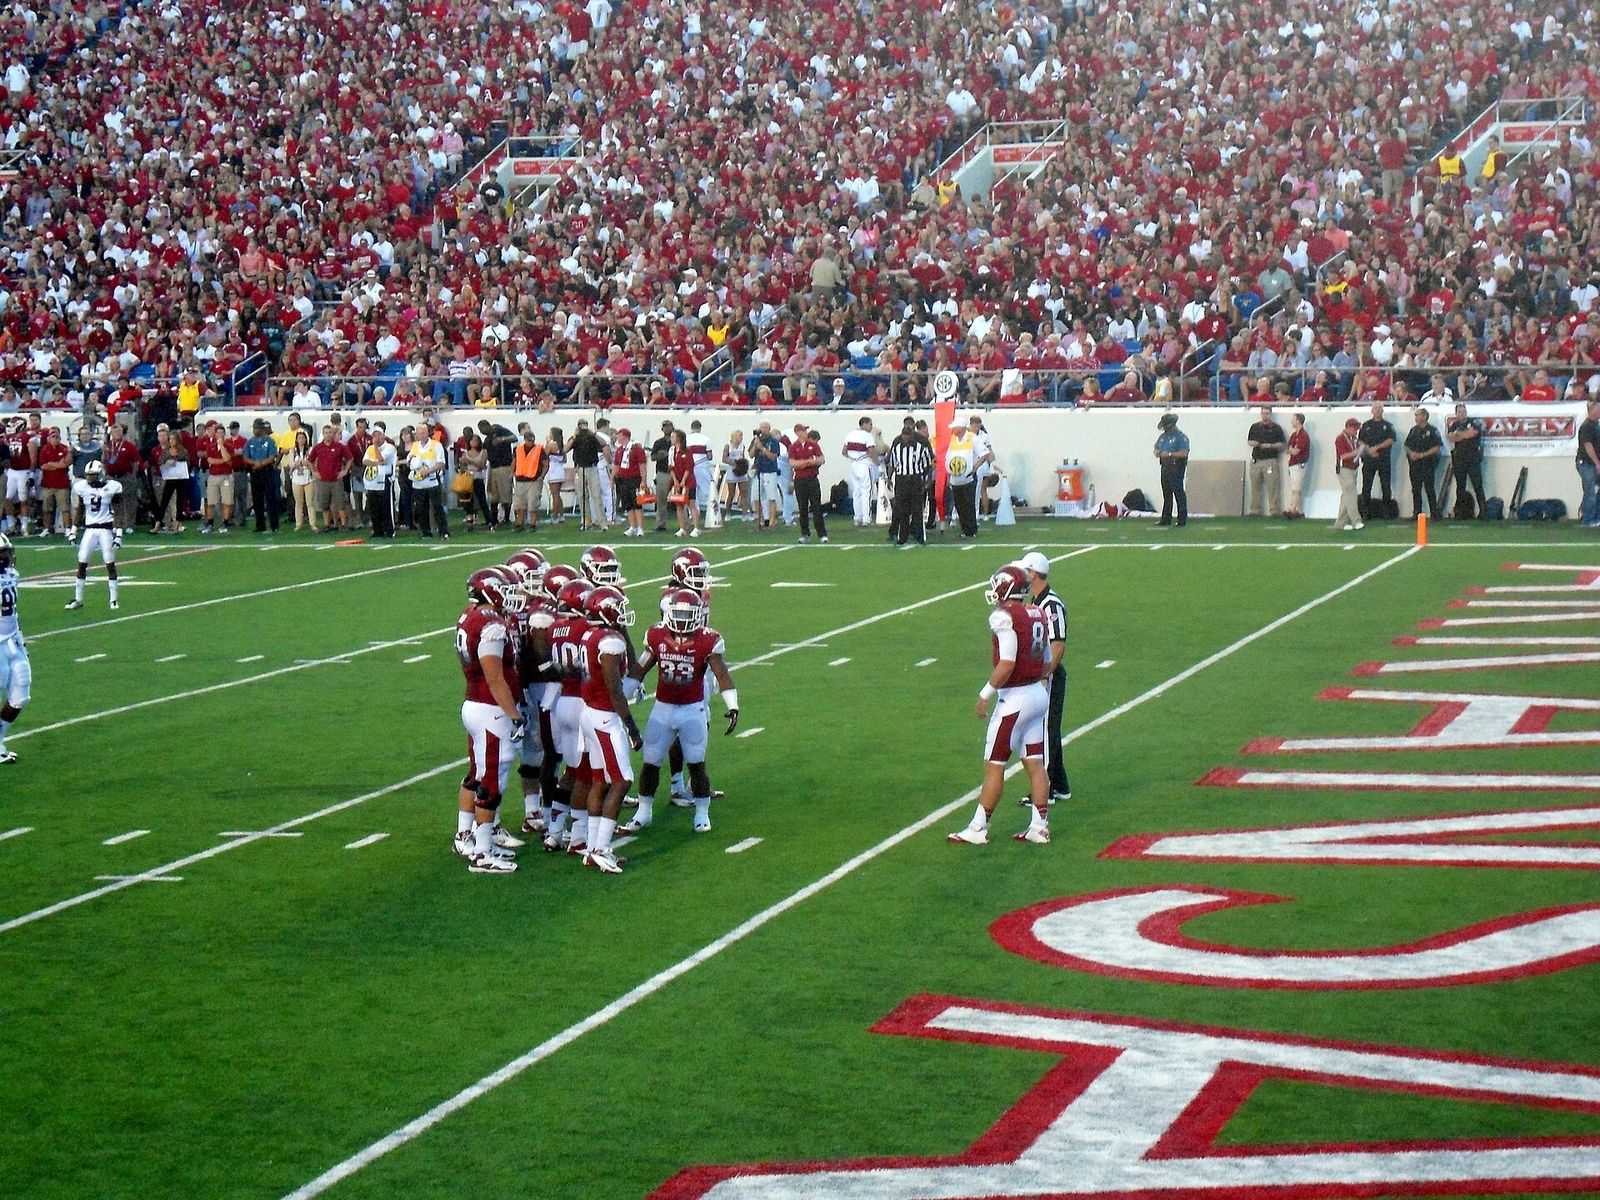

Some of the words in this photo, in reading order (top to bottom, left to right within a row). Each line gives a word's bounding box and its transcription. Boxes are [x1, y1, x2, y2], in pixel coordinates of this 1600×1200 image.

[91, 494, 102, 512] 9
[1031, 621, 1044, 657] 8
[660, 660, 695, 685] 33
